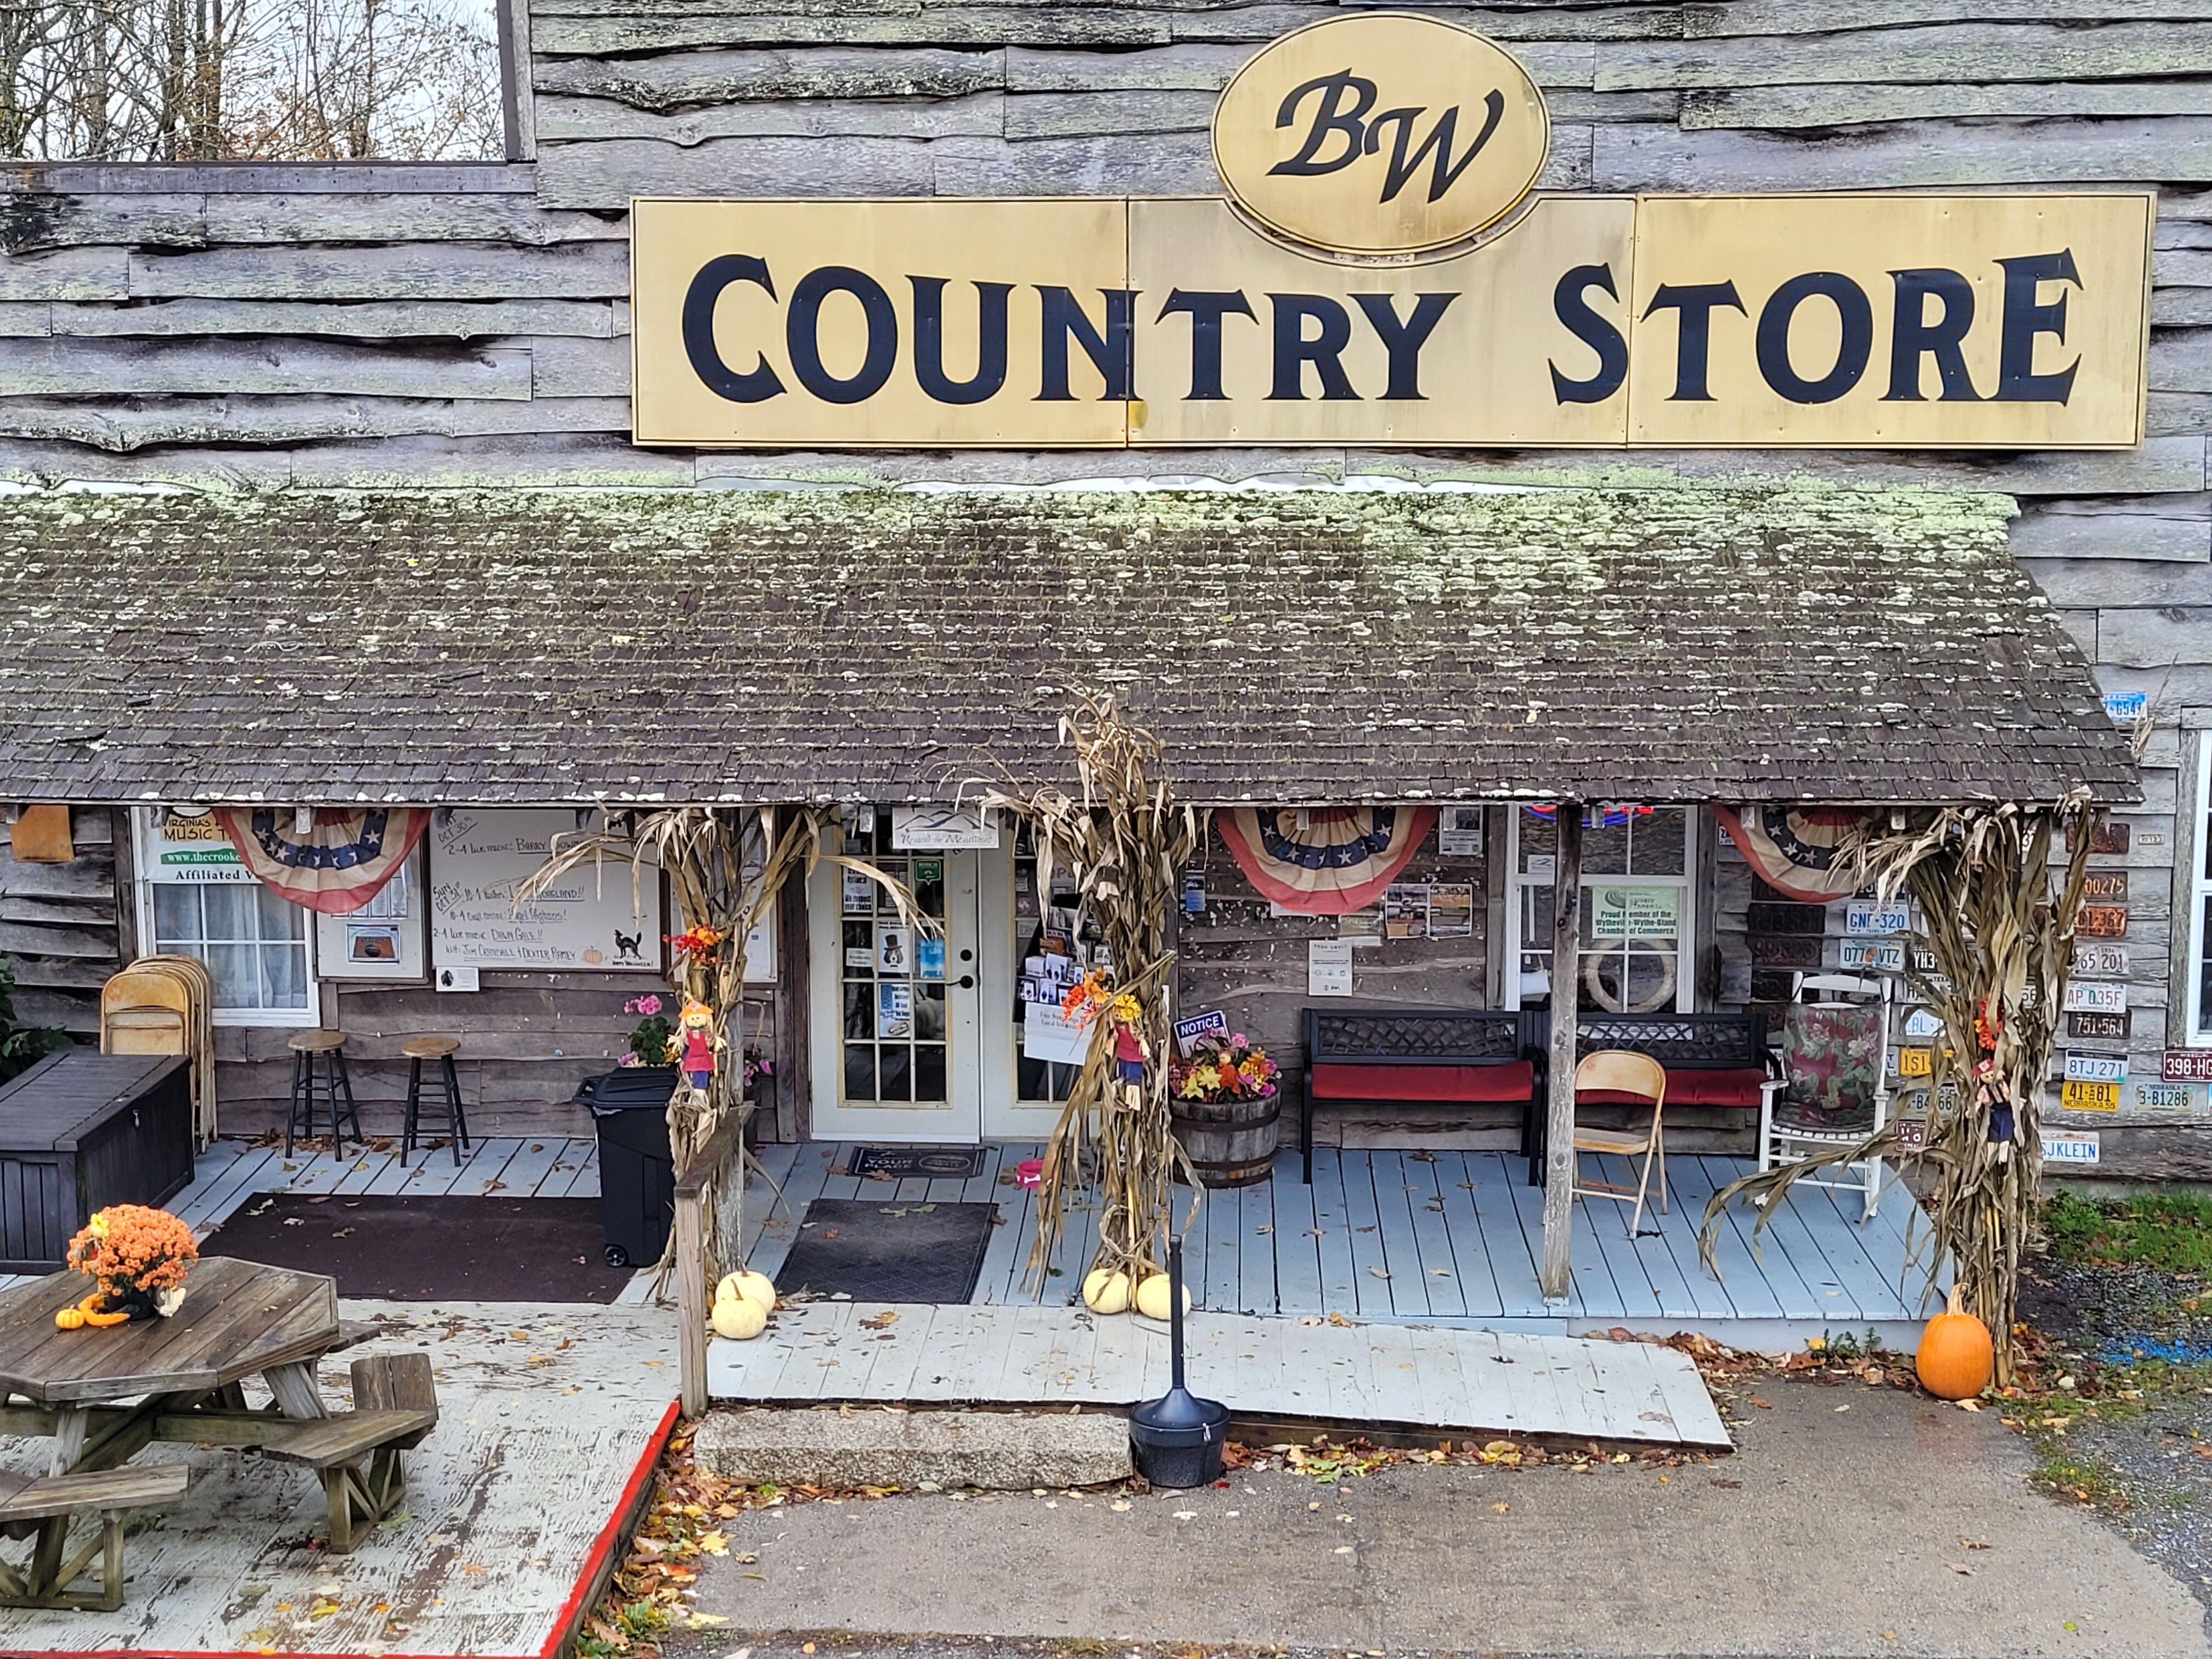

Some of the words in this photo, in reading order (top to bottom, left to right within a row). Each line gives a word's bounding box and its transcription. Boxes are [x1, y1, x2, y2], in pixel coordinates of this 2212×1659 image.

[1265, 67, 1504, 204] BW
[682, 255, 1462, 405] COUNTRY
[1548, 248, 2084, 407] STORE
[165, 829, 212, 841] MUSIC
[167, 851, 242, 862] www.thecrooke
[176, 870, 240, 879] Affiliated
[1181, 1015, 1220, 1036] NOTICE
